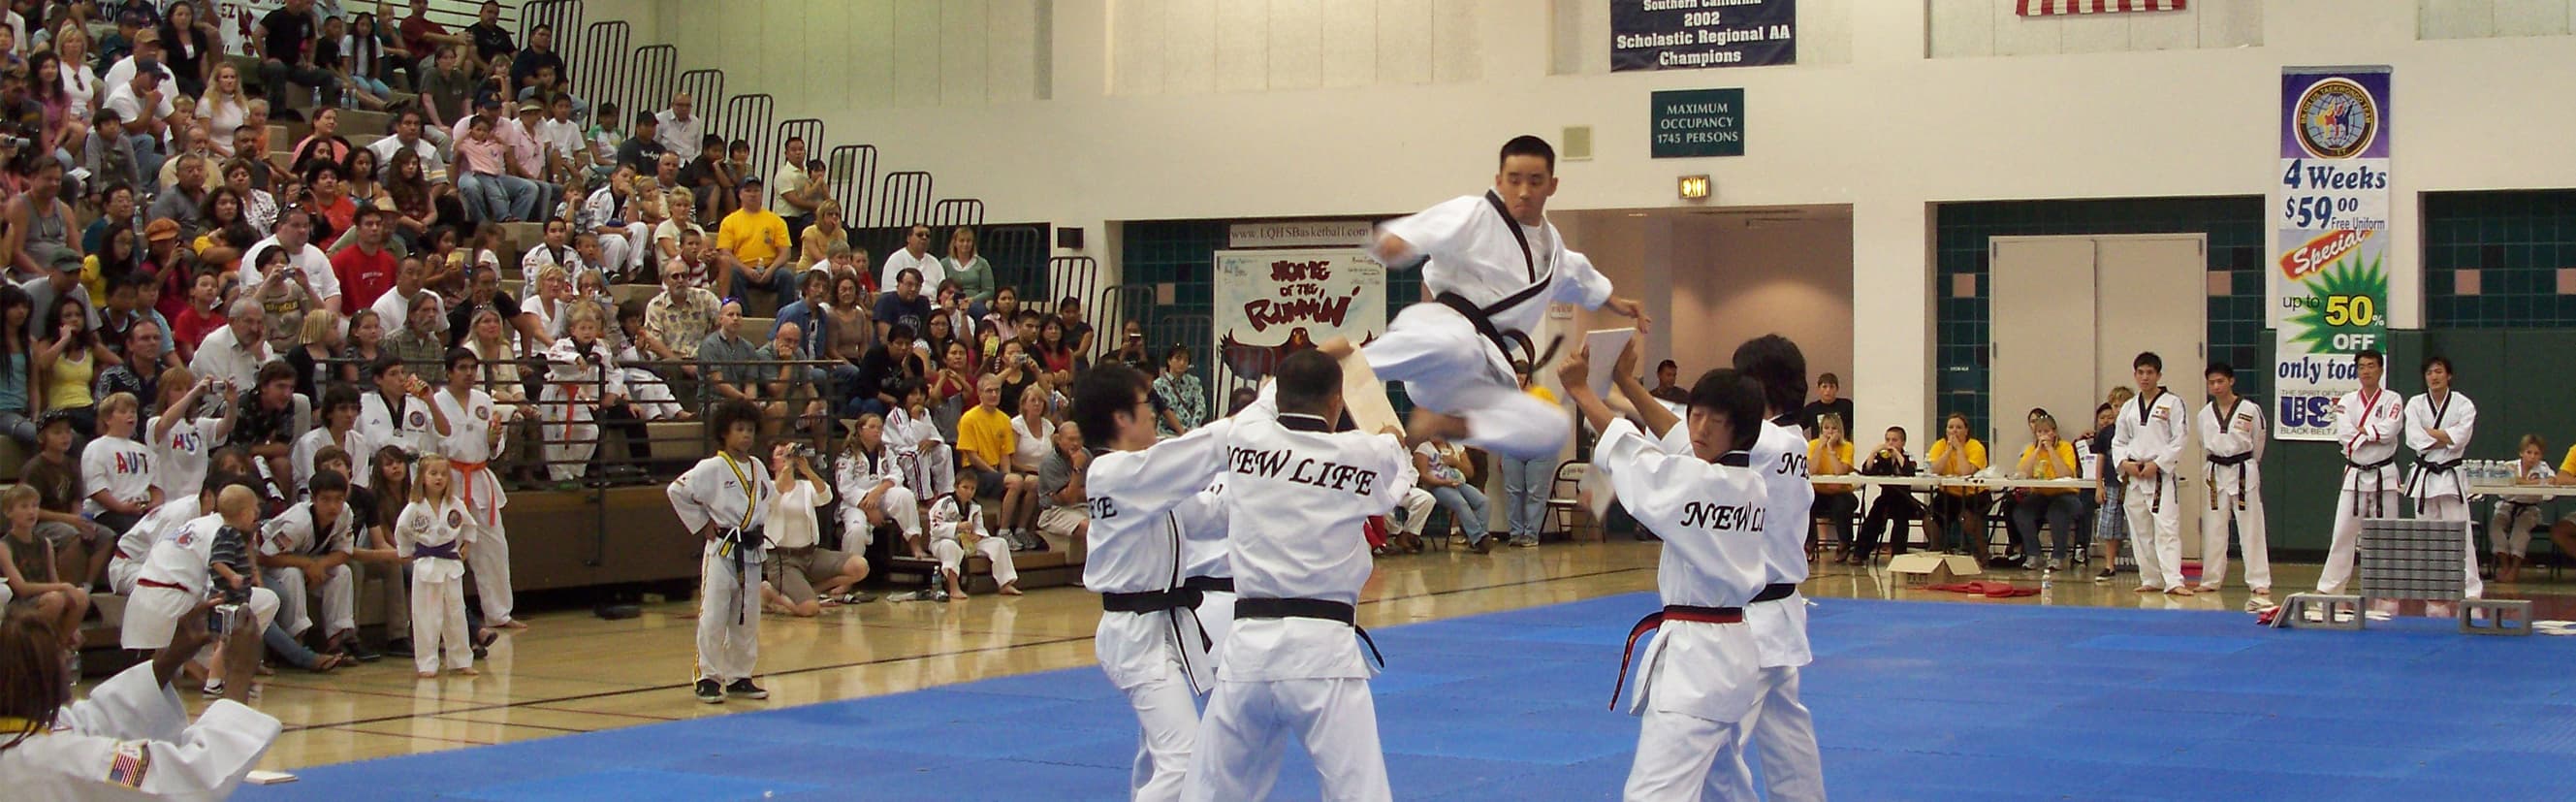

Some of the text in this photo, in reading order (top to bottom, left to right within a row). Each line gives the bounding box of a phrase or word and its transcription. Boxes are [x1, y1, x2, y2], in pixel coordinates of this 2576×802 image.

[1684, 12, 1720, 27] 2002
[1617, 24, 1791, 48] Scholastic Regional AA
[1660, 49, 1742, 67] Champions
[1667, 103, 1728, 114] MAXIMUM
[1661, 116, 1733, 130] OCCUPANCY
[1658, 131, 1738, 144] 1745 PERSONS
[2283, 159, 2387, 190] 4 Weeks
[2331, 216, 2385, 230] Free Uniform
[2292, 229, 2367, 274] Special
[1270, 260, 1331, 282] HOME
[1296, 283, 1319, 297] THE
[2282, 297, 2304, 311] up
[2306, 295, 2320, 309] to
[2333, 334, 2375, 350] OFF
[2278, 356, 2321, 385] only
[1288, 459, 1377, 496] LIFE
[1680, 500, 1751, 532] NEW
